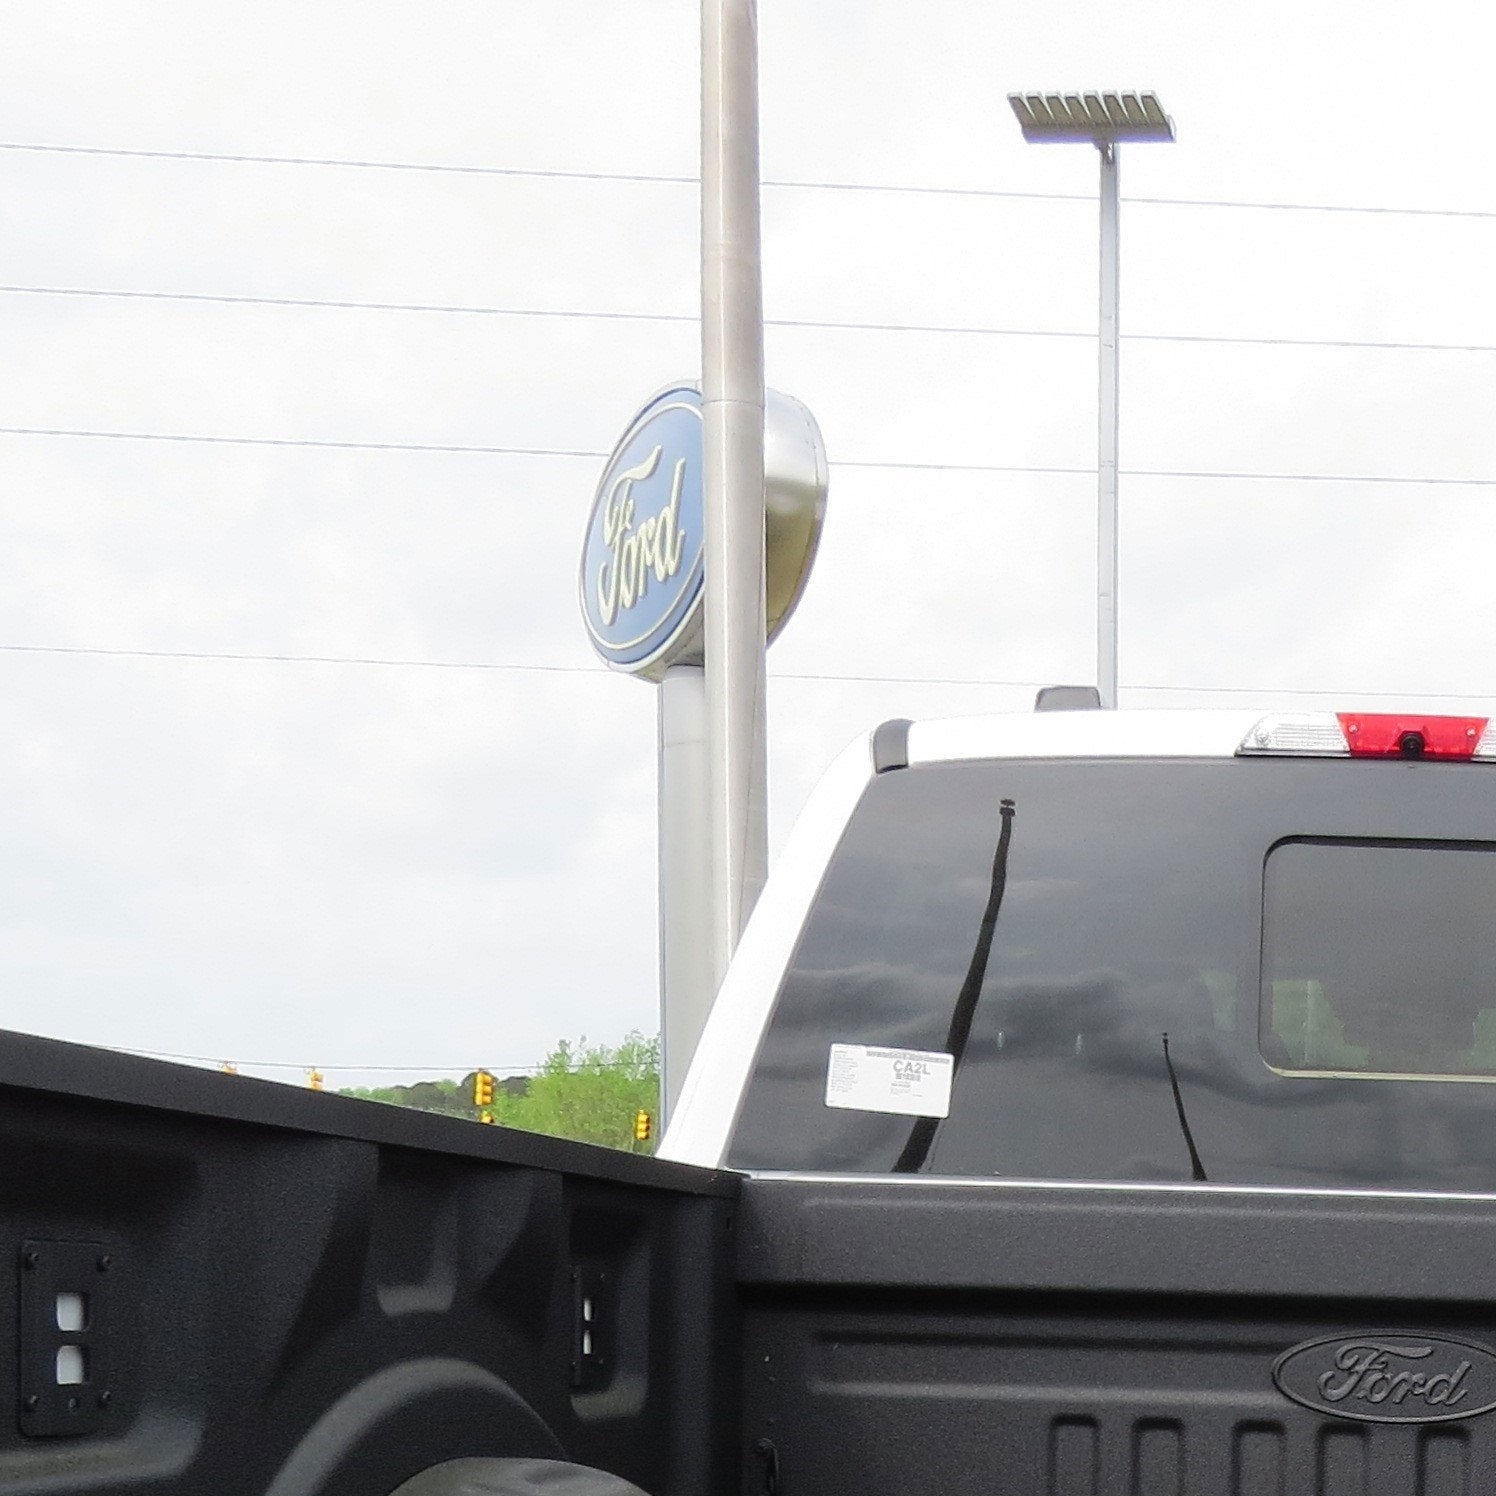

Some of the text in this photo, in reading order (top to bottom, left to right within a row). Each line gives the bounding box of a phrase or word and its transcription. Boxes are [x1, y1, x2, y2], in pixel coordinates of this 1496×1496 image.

[596, 444, 686, 627] Ford
[892, 1059, 931, 1075] CA2L
[1317, 1342, 1472, 1406] Ford
